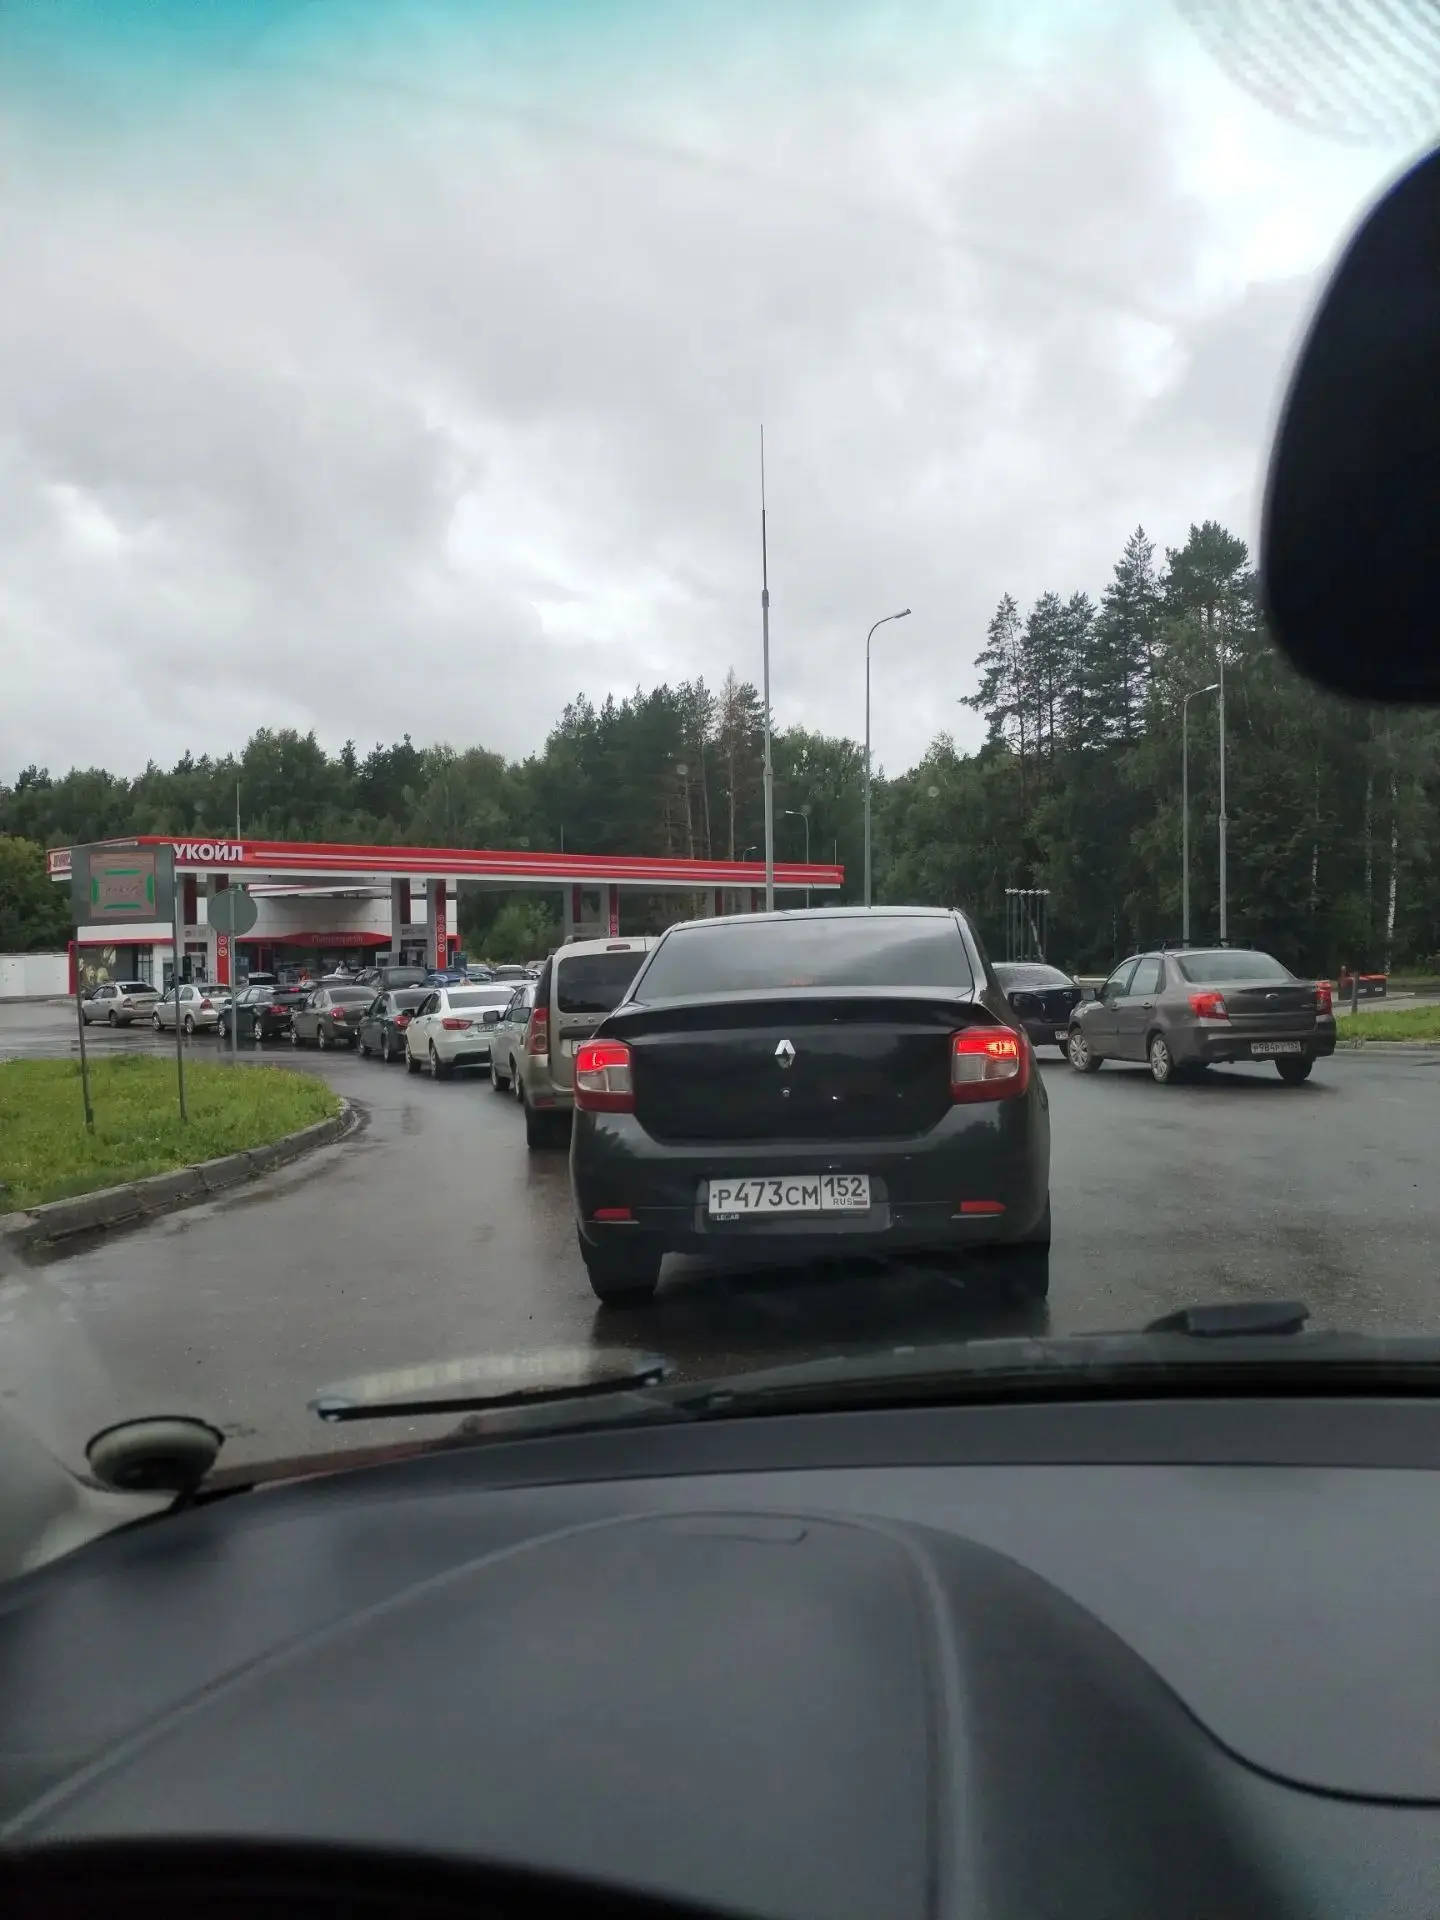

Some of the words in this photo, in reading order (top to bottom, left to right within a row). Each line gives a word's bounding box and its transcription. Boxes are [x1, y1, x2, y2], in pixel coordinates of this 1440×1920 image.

[718, 1182, 818, 1208] Р473СМ
[824, 1177, 863, 1197] 152
[833, 1198, 853, 1206] RUS
